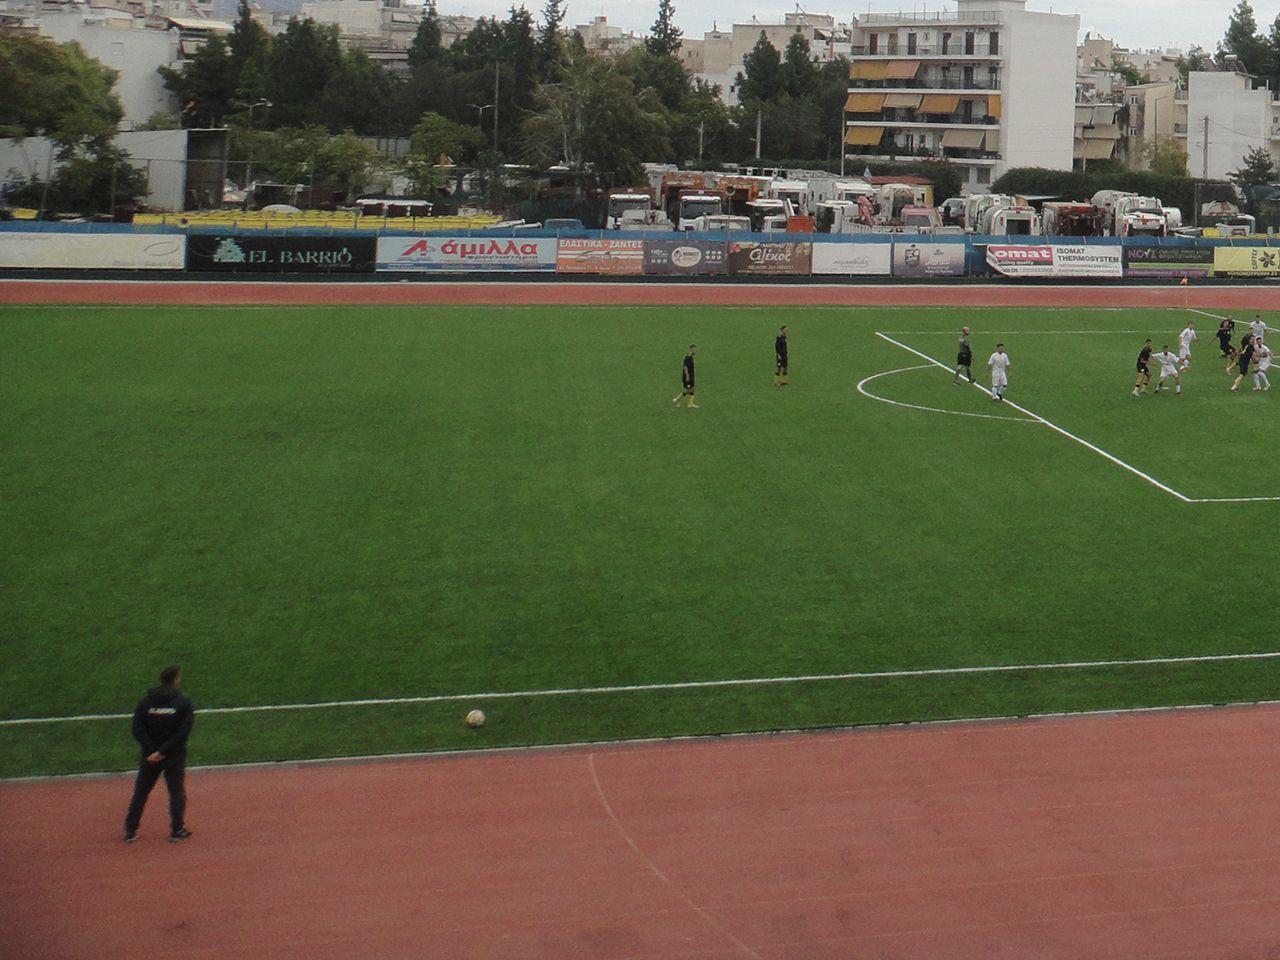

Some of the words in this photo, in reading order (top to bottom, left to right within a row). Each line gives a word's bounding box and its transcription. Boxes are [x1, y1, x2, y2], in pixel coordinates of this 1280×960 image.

[440, 239, 538, 258] άμιλλα
[559, 239, 602, 248] ΕΛΑΣΤΙΚΑ
[609, 240, 644, 249] ΖΑΝΤΕΣ
[249, 249, 275, 263] EL
[1057, 255, 1120, 263] THERMOSYSTEM
